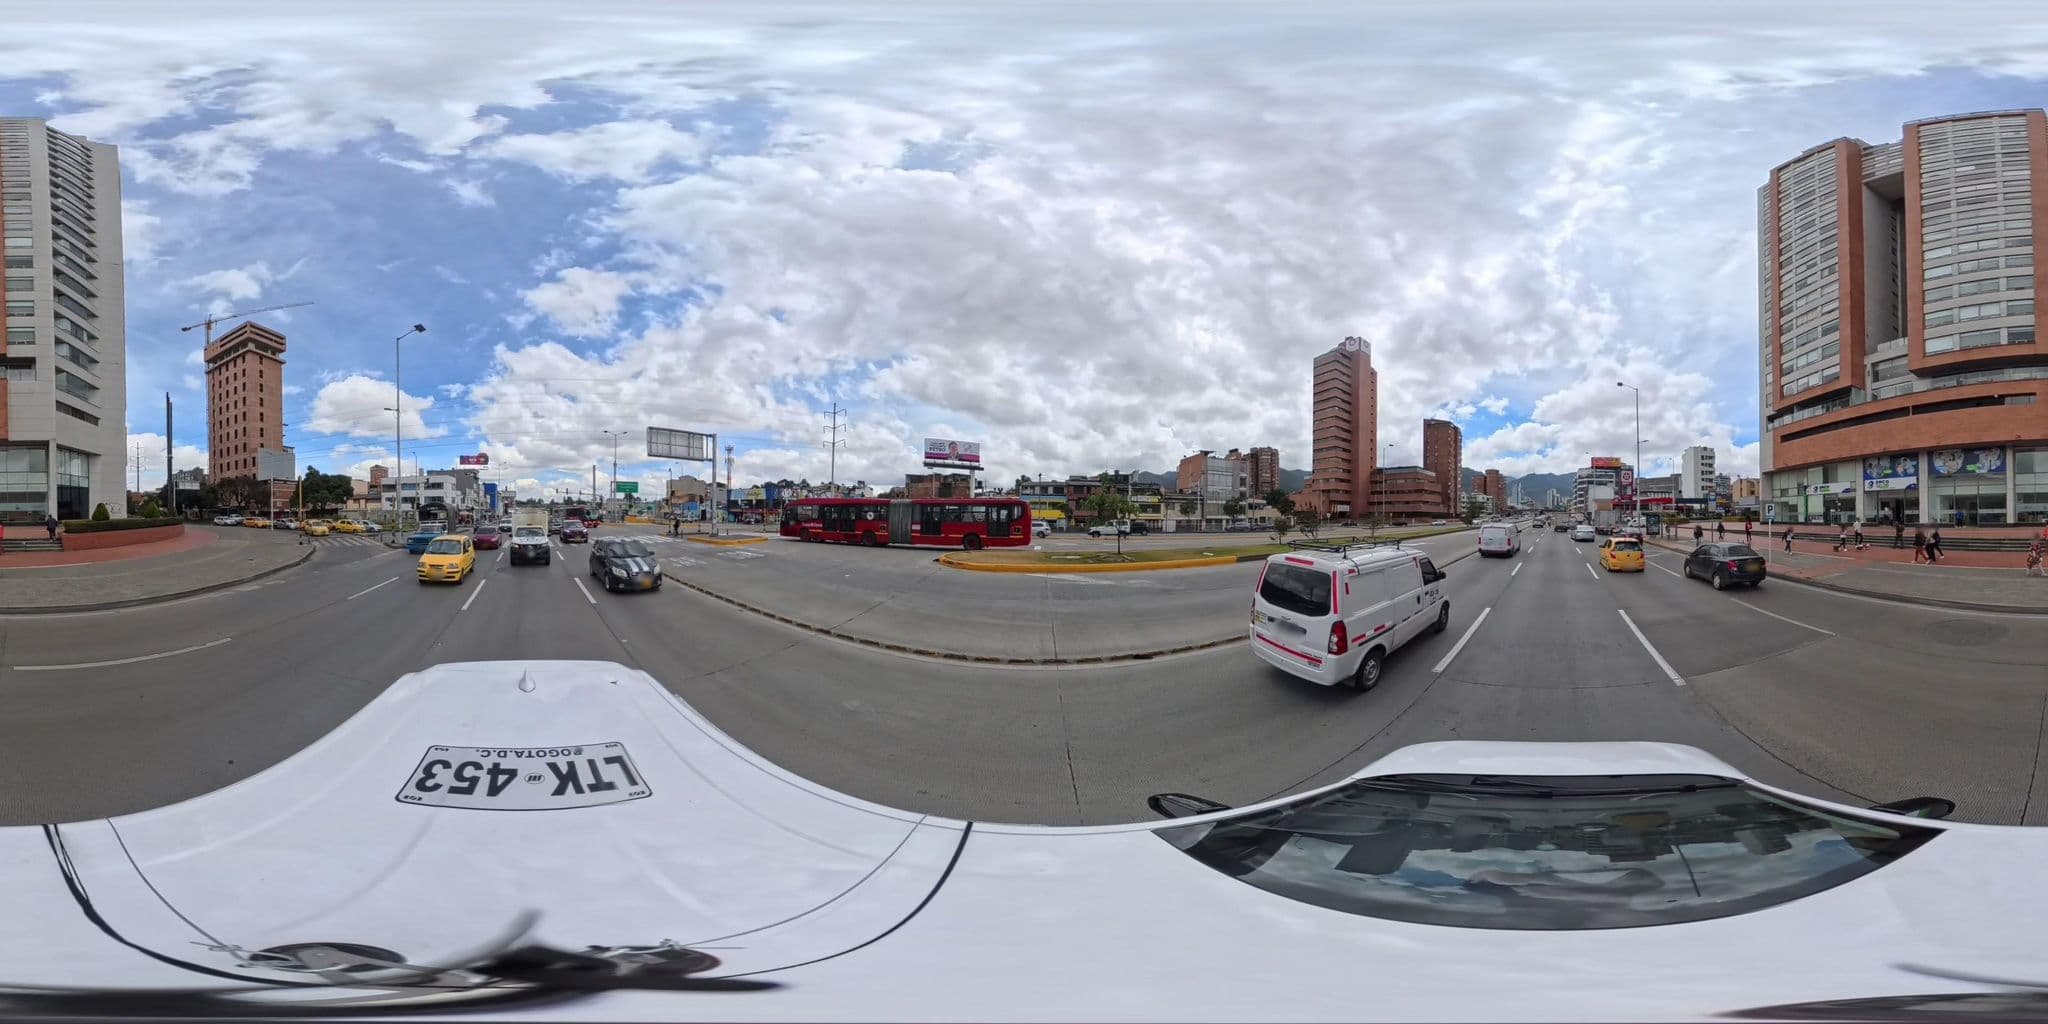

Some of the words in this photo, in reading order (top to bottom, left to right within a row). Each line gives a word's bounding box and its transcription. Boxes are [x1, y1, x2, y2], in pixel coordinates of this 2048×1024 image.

[1767, 505, 1773, 515] P
[415, 759, 518, 797] 453
[545, 755, 639, 796] LTK
